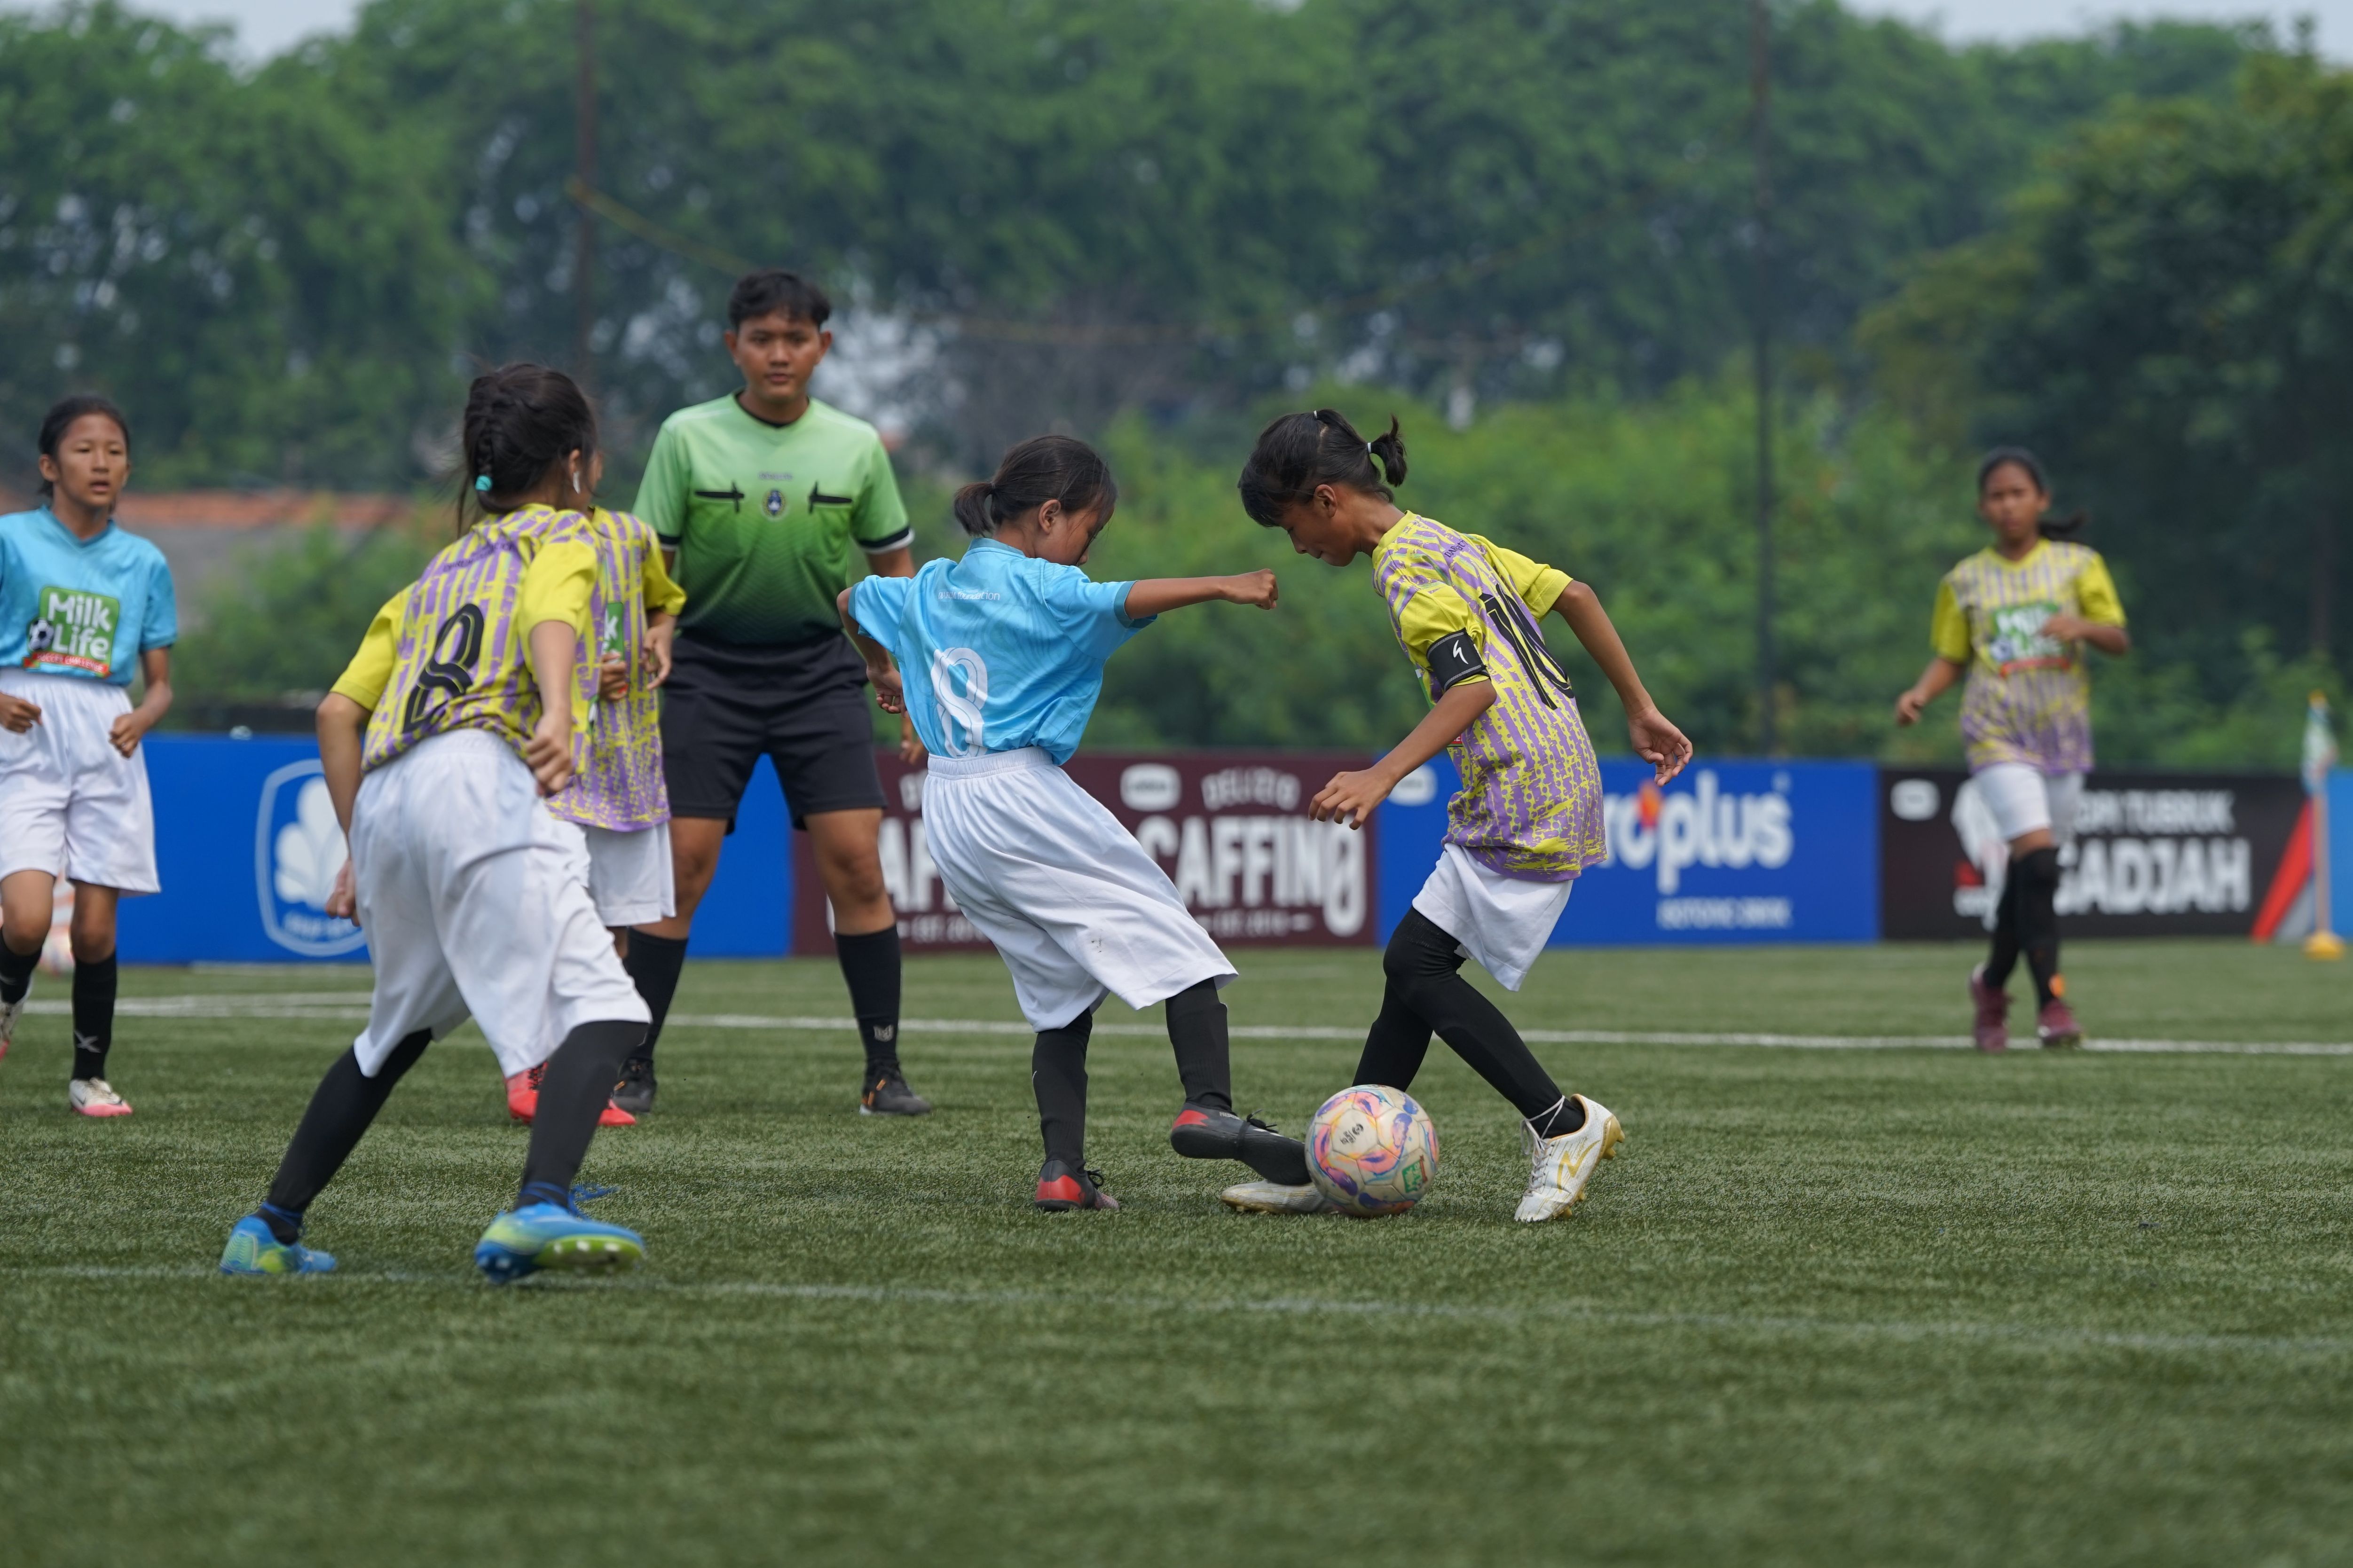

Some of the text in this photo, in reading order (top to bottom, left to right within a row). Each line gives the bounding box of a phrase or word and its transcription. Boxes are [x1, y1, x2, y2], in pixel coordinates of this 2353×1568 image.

[47, 593, 112, 632] Milk
[52, 624, 109, 660] Life
[402, 604, 484, 733] 8
[1479, 583, 1574, 710] 10
[930, 647, 988, 759] 8
